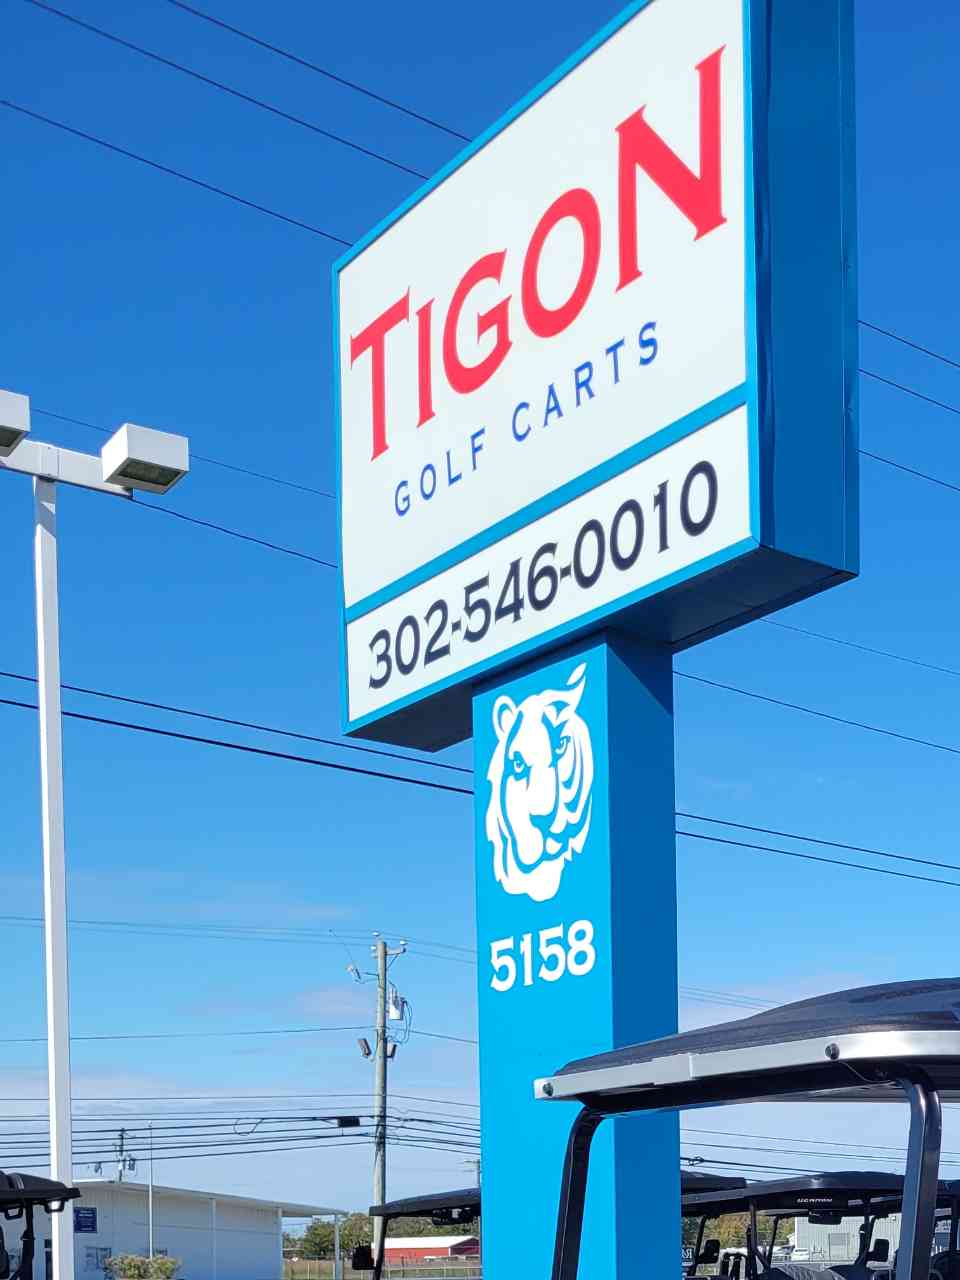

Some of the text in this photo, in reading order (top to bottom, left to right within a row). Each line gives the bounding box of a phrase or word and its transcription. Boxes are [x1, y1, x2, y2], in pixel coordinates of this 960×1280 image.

[350, 45, 728, 461] TIGON
[394, 321, 659, 518] GOLF CARTS
[368, 460, 719, 690] 302-546-0010
[490, 919, 596, 992] 5158
